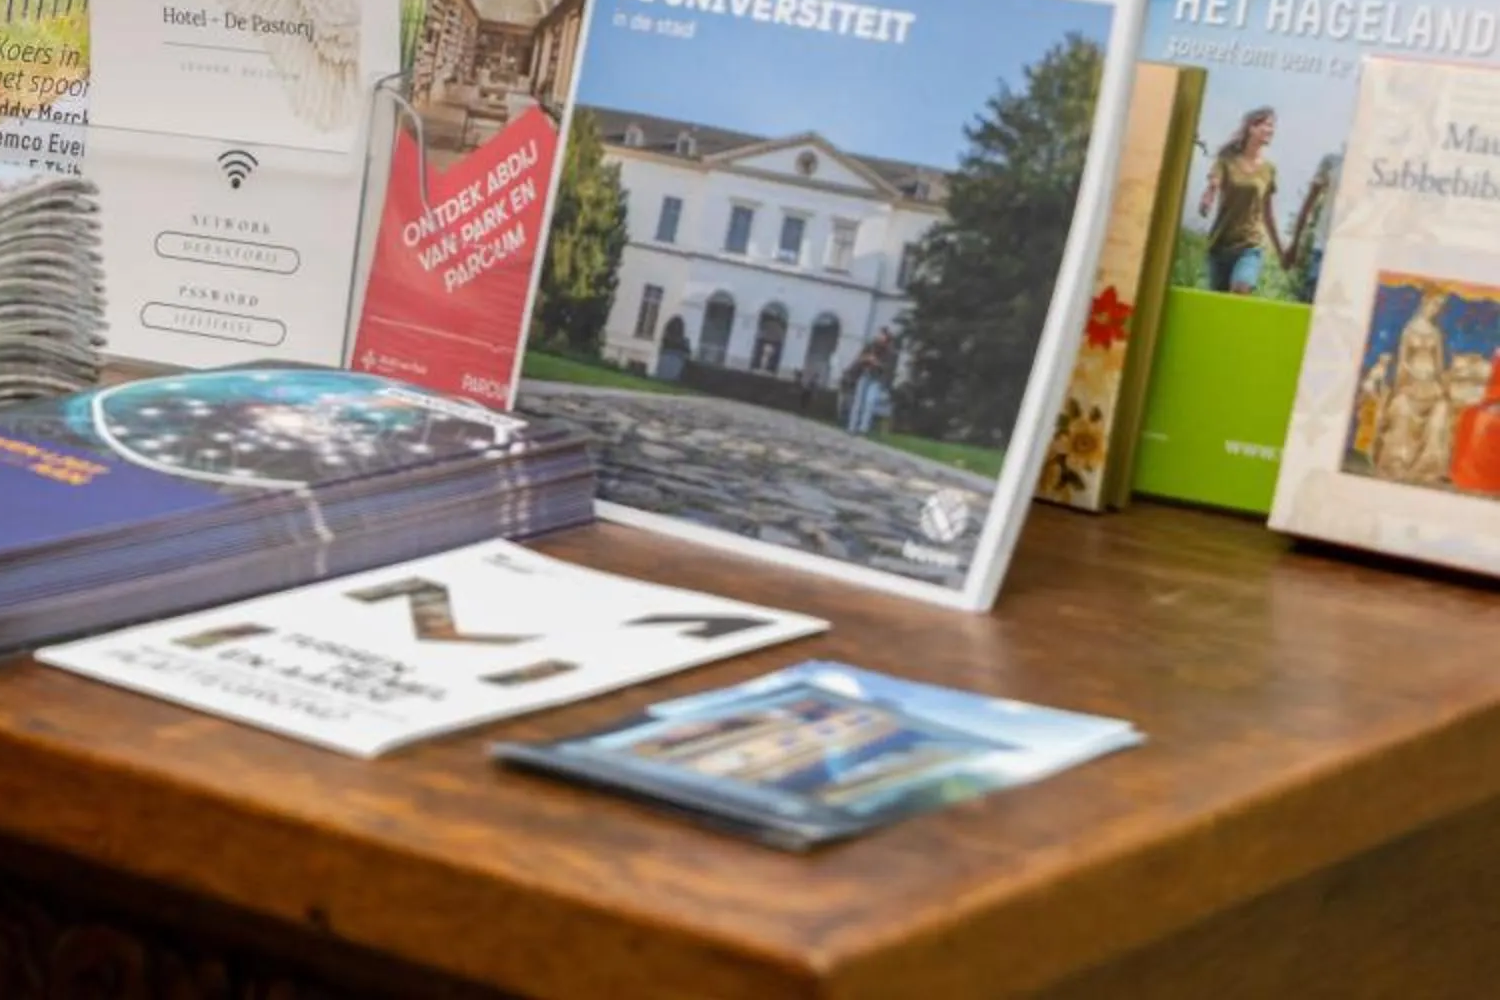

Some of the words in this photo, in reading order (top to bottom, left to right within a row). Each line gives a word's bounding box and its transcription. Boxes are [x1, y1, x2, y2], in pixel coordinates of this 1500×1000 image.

[163, 6, 207, 28] Hotel
[225, 11, 248, 31] De
[252, 13, 316, 43] Pastorij
[613, 7, 627, 27] in
[629, 10, 653, 33] de
[655, 14, 695, 40] stad
[59, 41, 80, 66] in
[402, 180, 485, 248] ONTDEK
[487, 138, 540, 200] ABDIJ
[417, 231, 458, 272] VAN
[459, 203, 509, 246] PARK
[509, 176, 537, 214] EN
[443, 221, 527, 294] PARCUM
